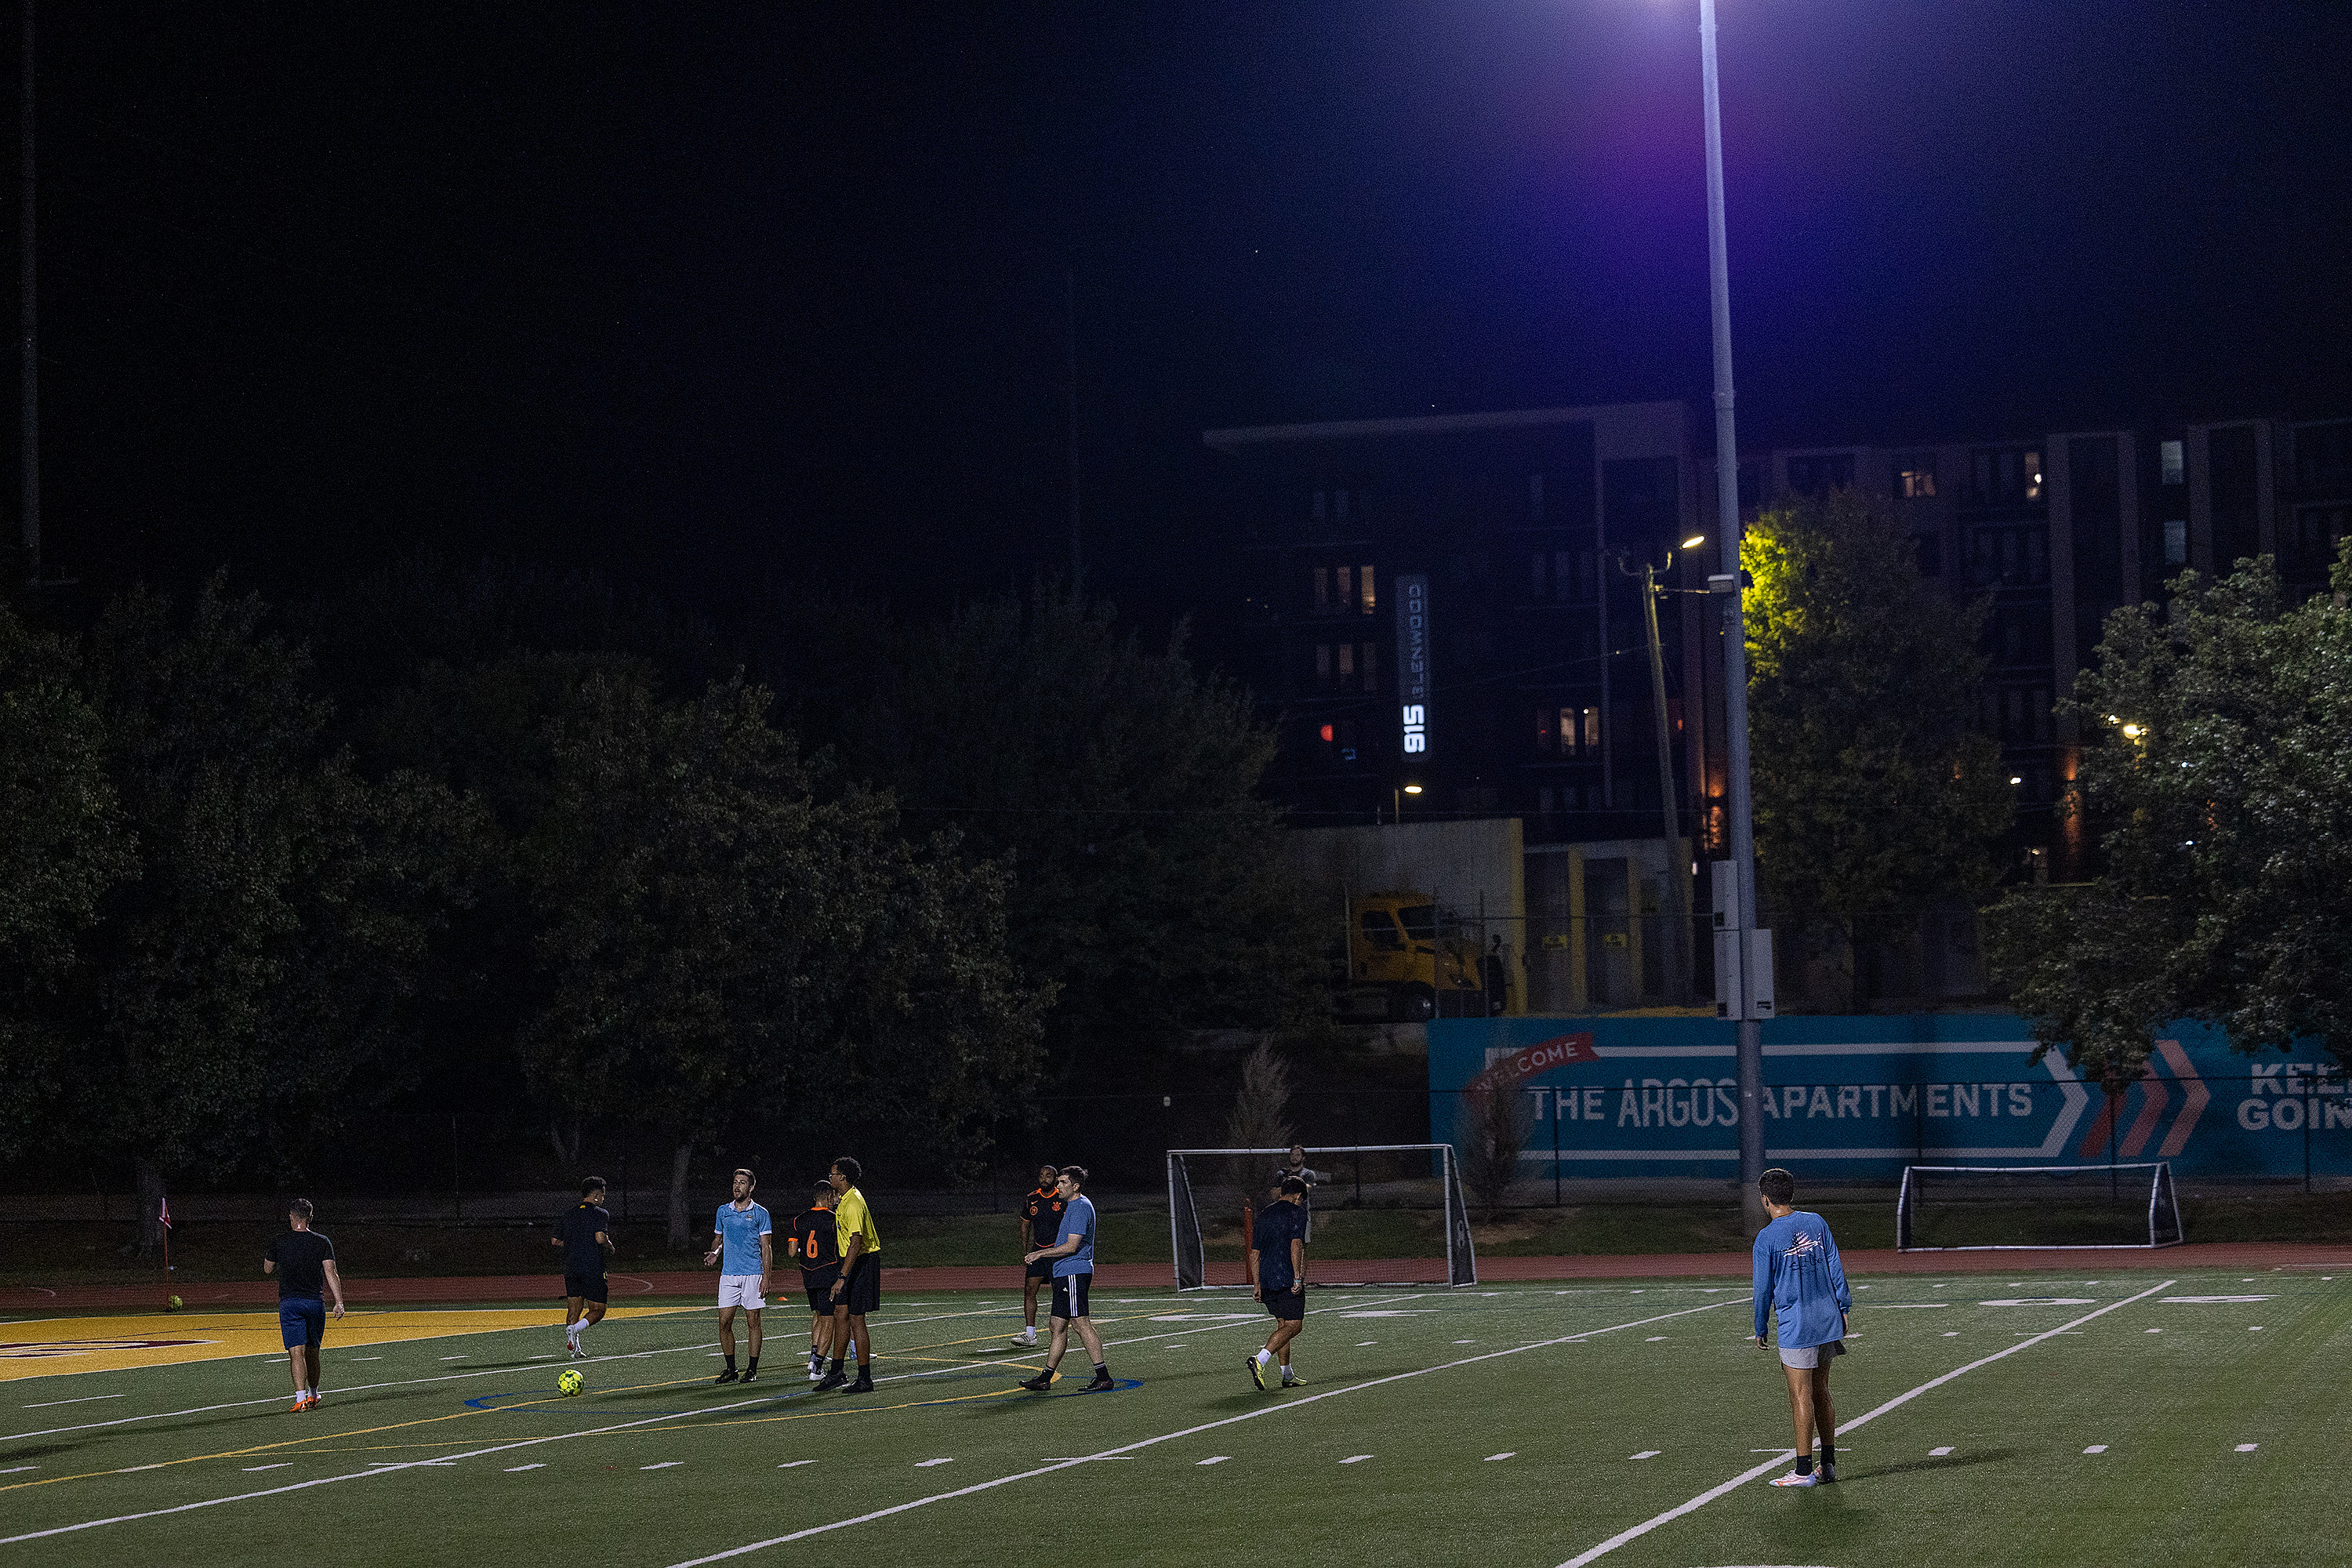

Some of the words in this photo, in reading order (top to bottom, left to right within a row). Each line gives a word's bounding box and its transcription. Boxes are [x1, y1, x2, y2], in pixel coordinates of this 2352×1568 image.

[1402, 704, 1426, 753] 915
[2250, 1062, 2352, 1095] KEE
[1528, 1086, 1605, 1120] THE
[1617, 1077, 1740, 1128] ARGOS
[1762, 1083, 2033, 1120] APARTMENTS
[806, 1229, 818, 1259] 6
